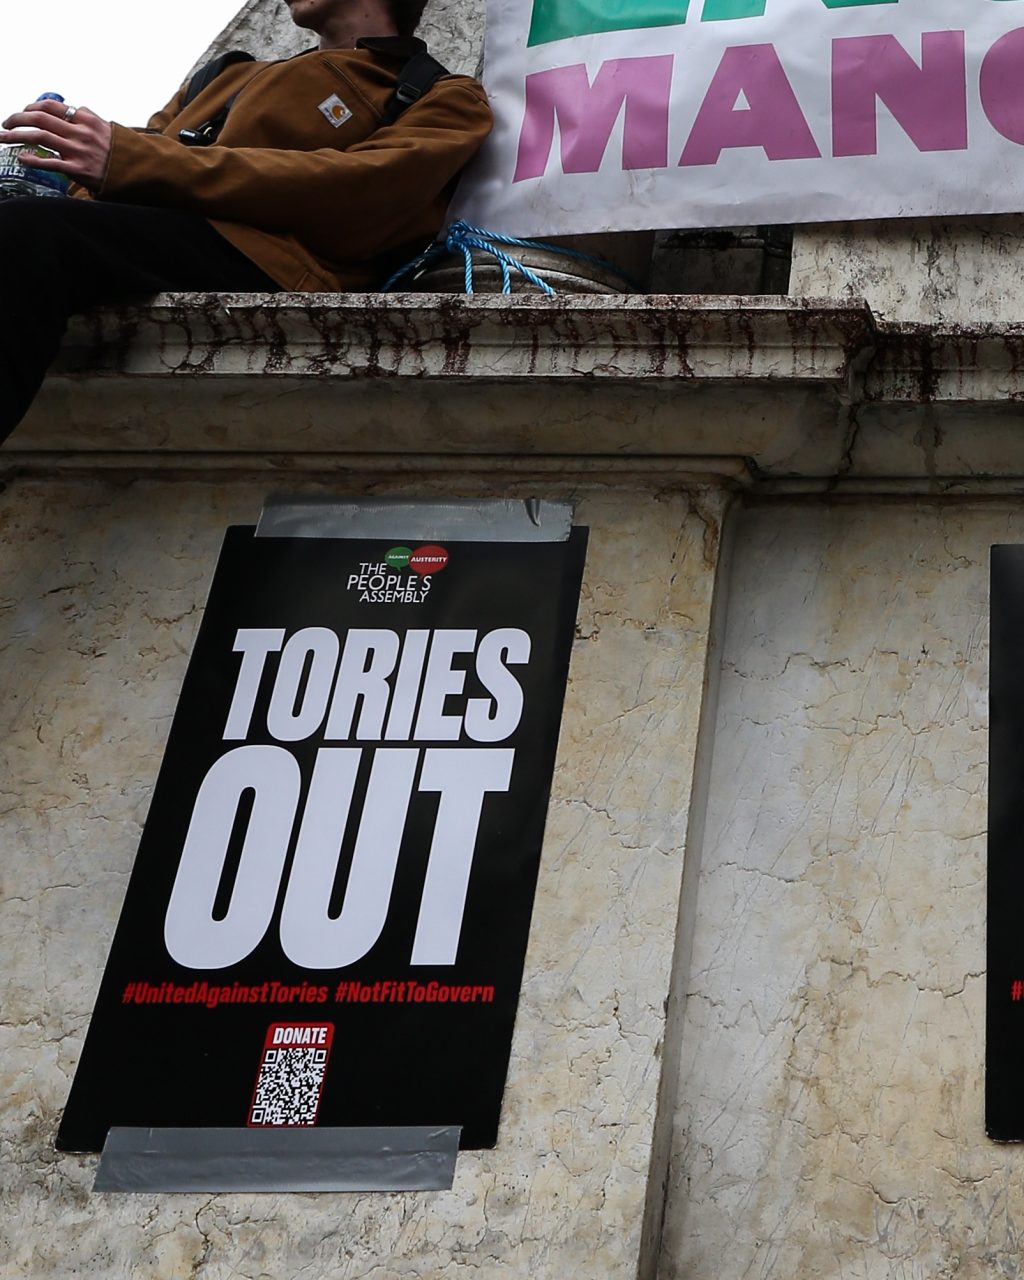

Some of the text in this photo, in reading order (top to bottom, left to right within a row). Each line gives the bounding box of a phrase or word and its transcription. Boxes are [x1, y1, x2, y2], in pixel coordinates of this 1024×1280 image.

[359, 563, 388, 575] THE
[359, 590, 429, 603] ASSEMBLY
[222, 627, 532, 743] TORIES
[164, 744, 515, 969] OUT
[121, 981, 495, 1008] #UnitedAgainstTories #NotFitToGovern
[272, 1027, 328, 1044] DONATE
